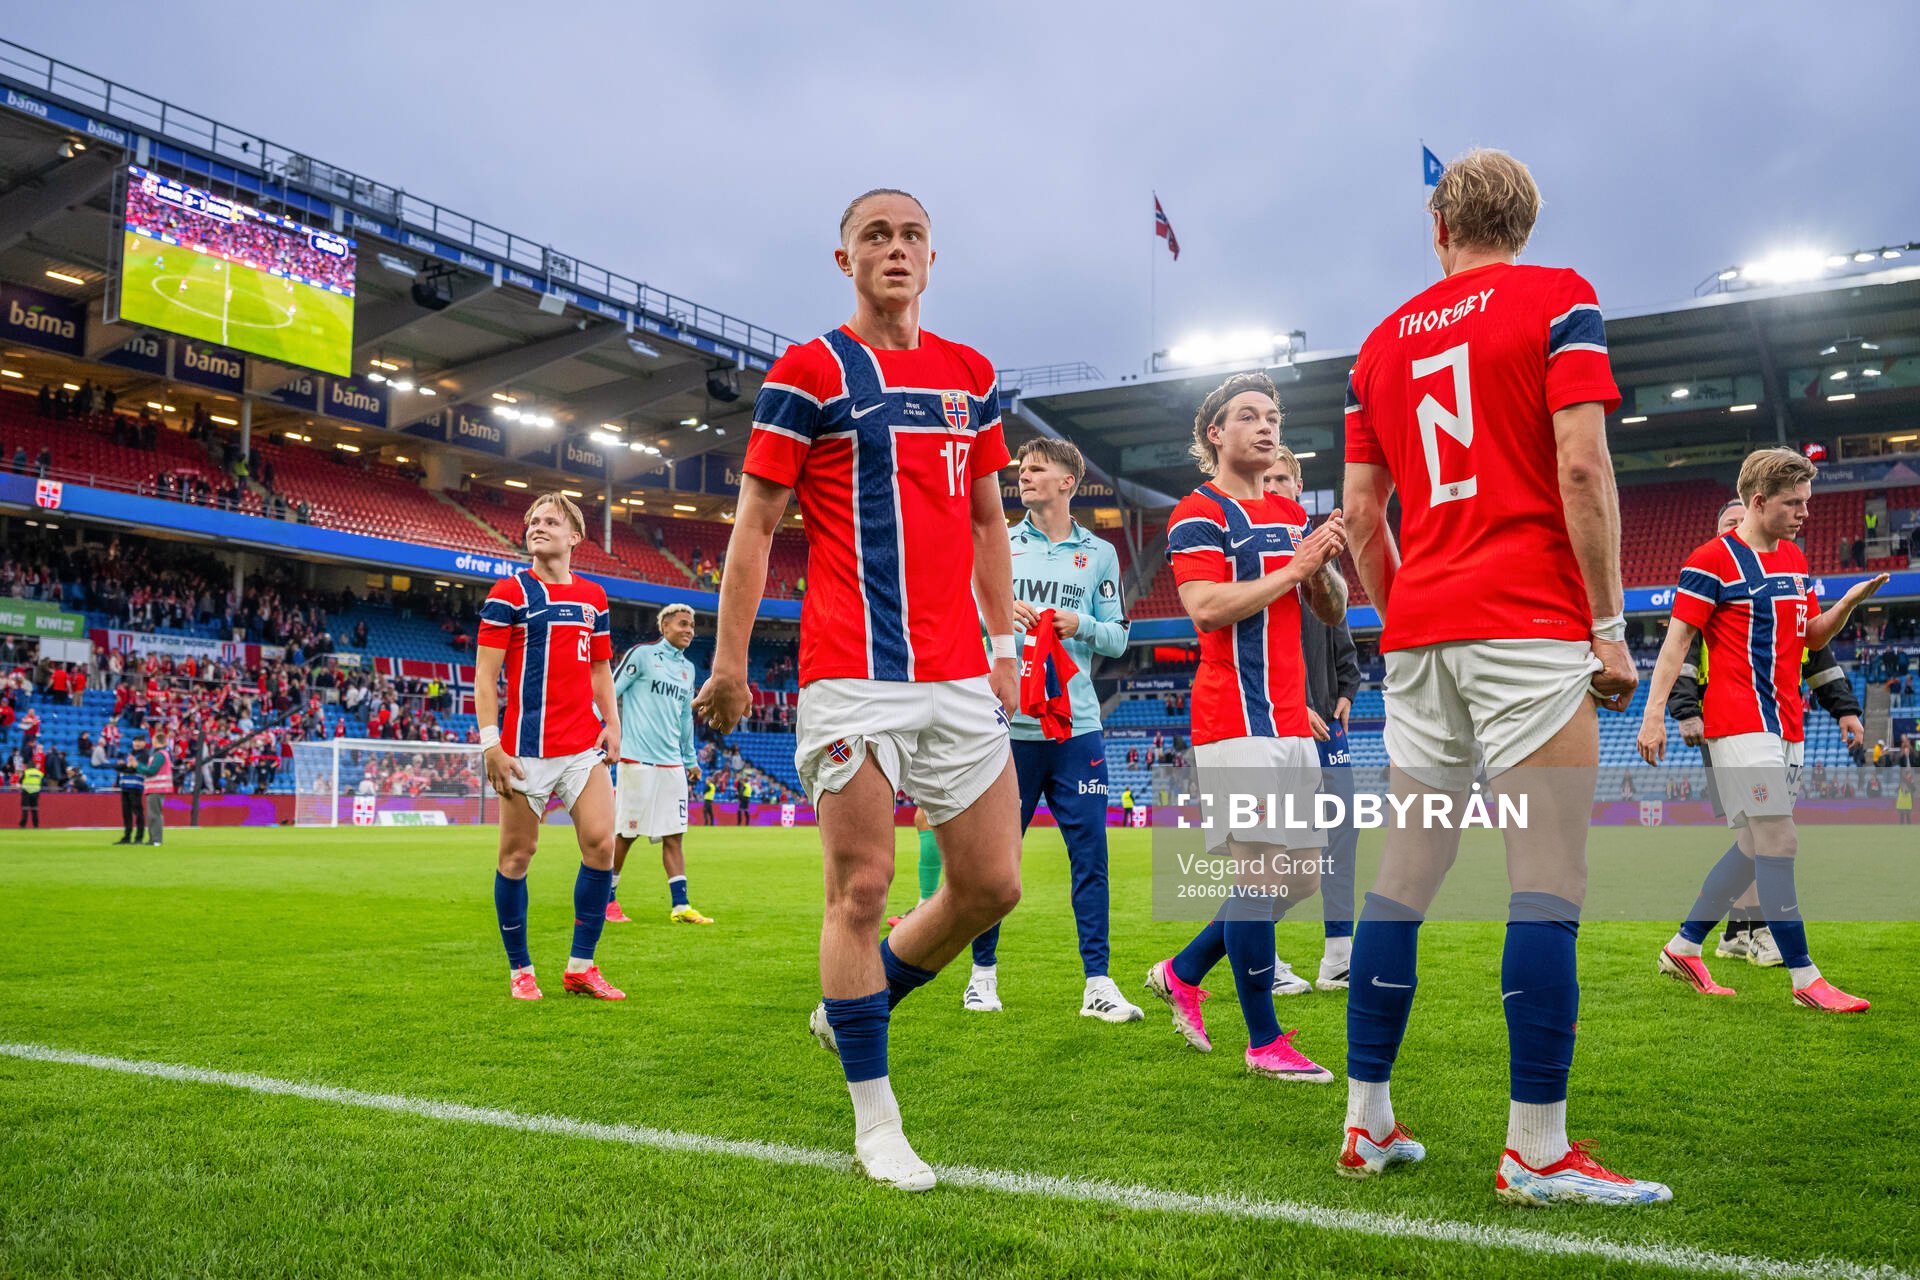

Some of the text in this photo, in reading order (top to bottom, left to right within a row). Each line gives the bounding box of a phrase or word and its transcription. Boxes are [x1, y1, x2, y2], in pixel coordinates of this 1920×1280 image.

[7, 90, 48, 117] bama
[87, 119, 125, 144] bama
[9, 300, 76, 339] bama
[1399, 288, 1494, 338] THORSBY
[184, 344, 241, 379] bama
[332, 382, 380, 413] bama
[459, 415, 501, 443] bama
[1411, 341, 1478, 508] 2
[567, 443, 604, 468] bama
[455, 555, 492, 573] ofrer
[494, 561, 513, 577] alt
[1060, 595, 1080, 609] pris
[1062, 583, 1086, 598] mini
[36, 616, 62, 631] KIWI
[651, 680, 679, 699] KIWI
[1328, 749, 1351, 765] bam
